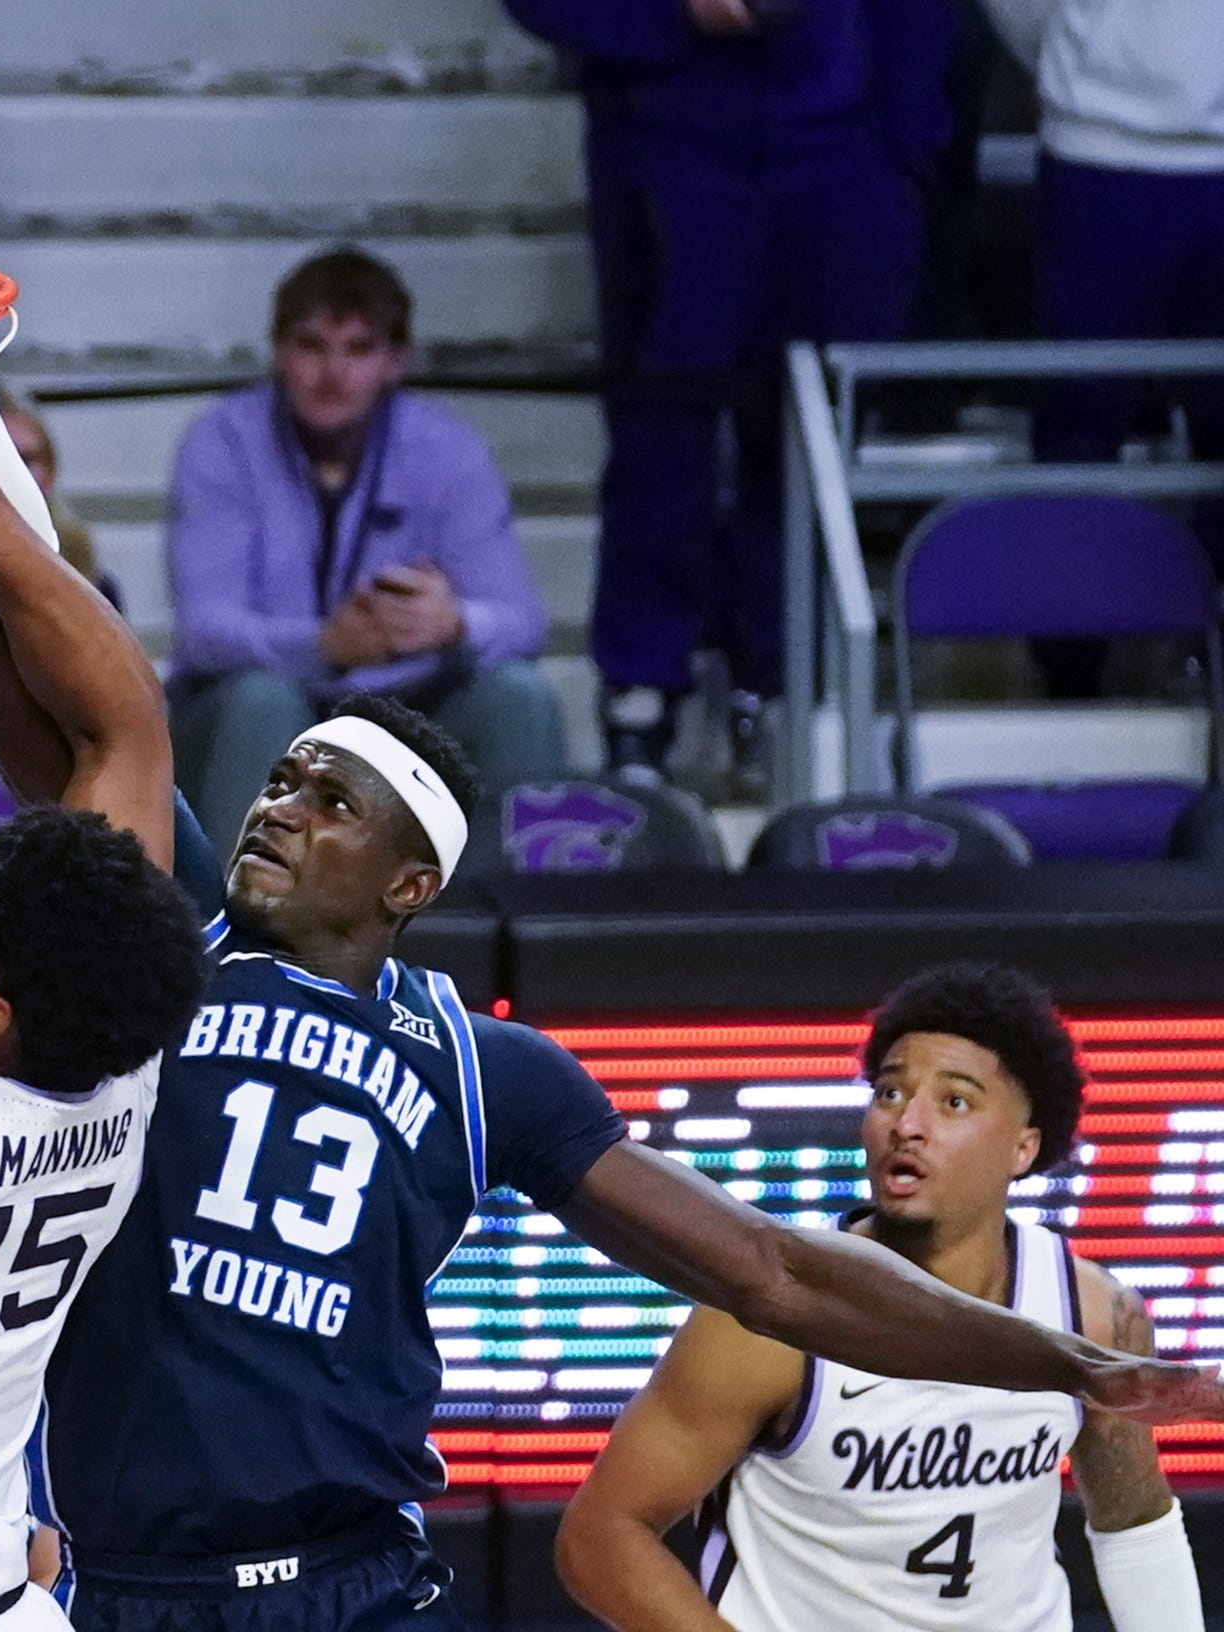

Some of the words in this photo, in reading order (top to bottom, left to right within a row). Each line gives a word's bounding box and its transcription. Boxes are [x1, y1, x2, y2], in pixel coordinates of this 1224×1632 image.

[180, 1004, 437, 1150] BRIGHAM
[195, 1079, 380, 1256] 13
[169, 1238, 352, 1338] YOUNG
[832, 1422, 1061, 1492] Wildcats
[235, 1556, 299, 1588] BYU
[905, 1512, 976, 1598] 4
